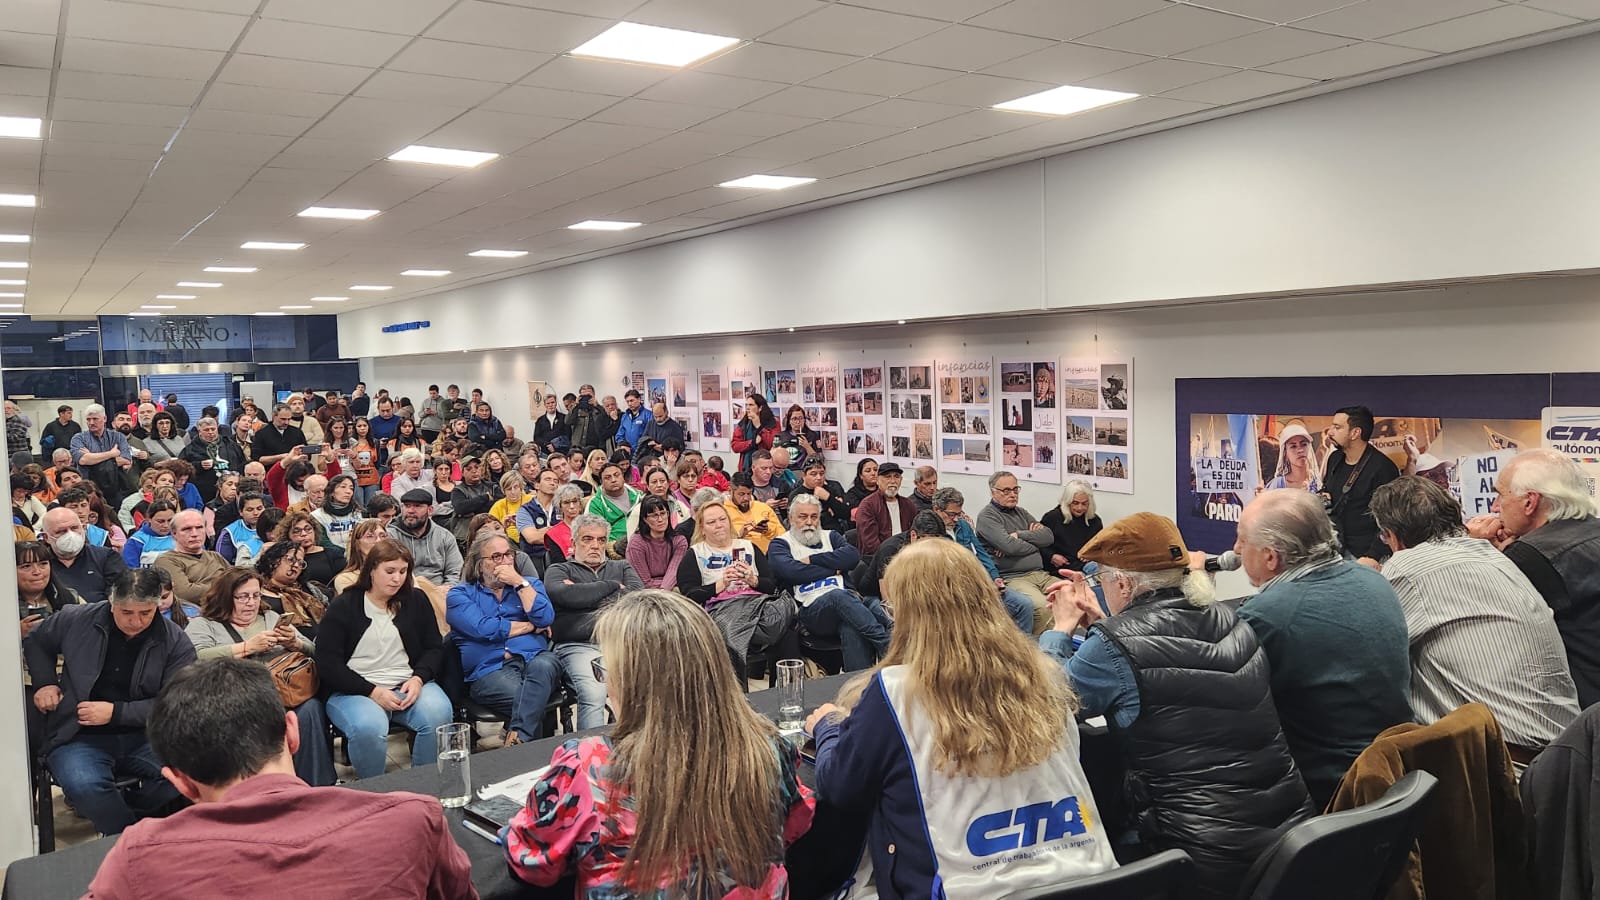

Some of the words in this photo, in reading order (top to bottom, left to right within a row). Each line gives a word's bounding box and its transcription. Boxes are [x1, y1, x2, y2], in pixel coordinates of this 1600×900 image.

[1546, 426, 1600, 441] CTA
[1201, 459, 1213, 469] LA
[1220, 460, 1247, 471] DEUDA
[1477, 457, 1497, 473] NO
[1212, 471, 1222, 480] ES
[1226, 472, 1241, 480] CON
[1203, 481, 1212, 489] EL
[1216, 481, 1243, 490] PUEBLO
[1480, 477, 1496, 493] AL
[799, 577, 839, 593] CTA
[966, 796, 1087, 857] CTA
[972, 857, 1000, 871] central
